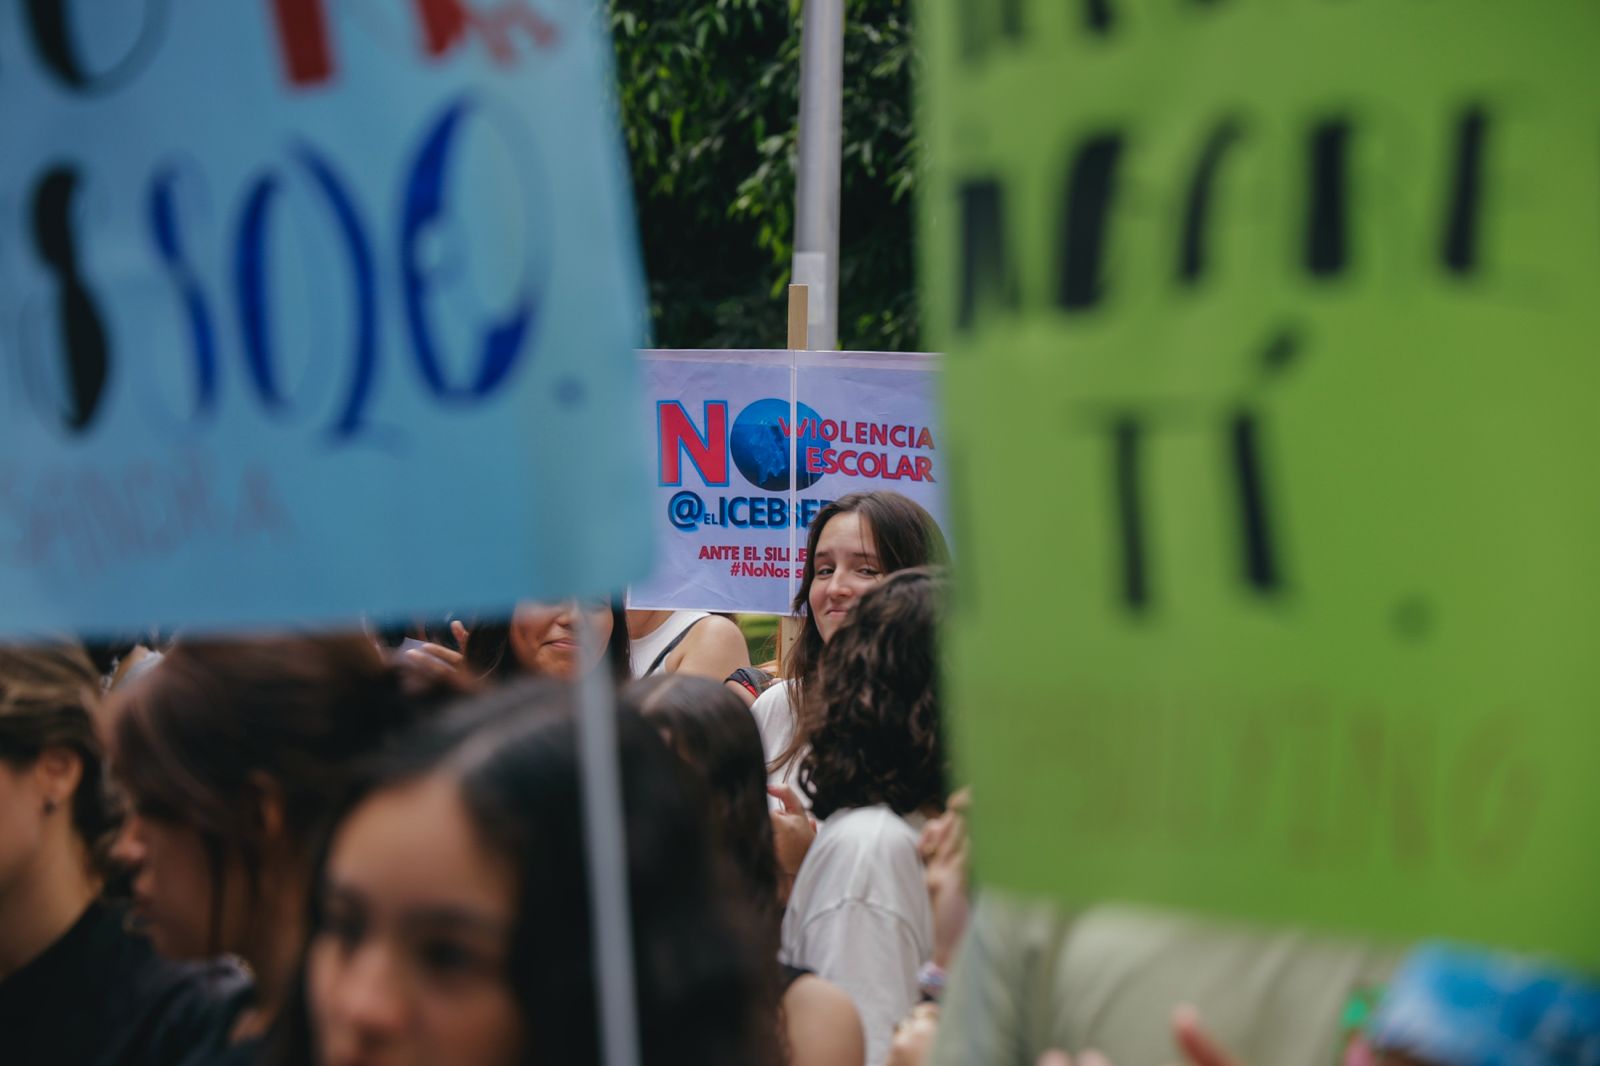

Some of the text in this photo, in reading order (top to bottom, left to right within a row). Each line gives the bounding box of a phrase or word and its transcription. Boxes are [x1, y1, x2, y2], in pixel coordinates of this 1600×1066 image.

[778, 416, 935, 450] VIOLENCIA
[805, 446, 937, 482] ESCOLAR
[699, 545, 740, 560] ANTE
[743, 546, 761, 561] EL
